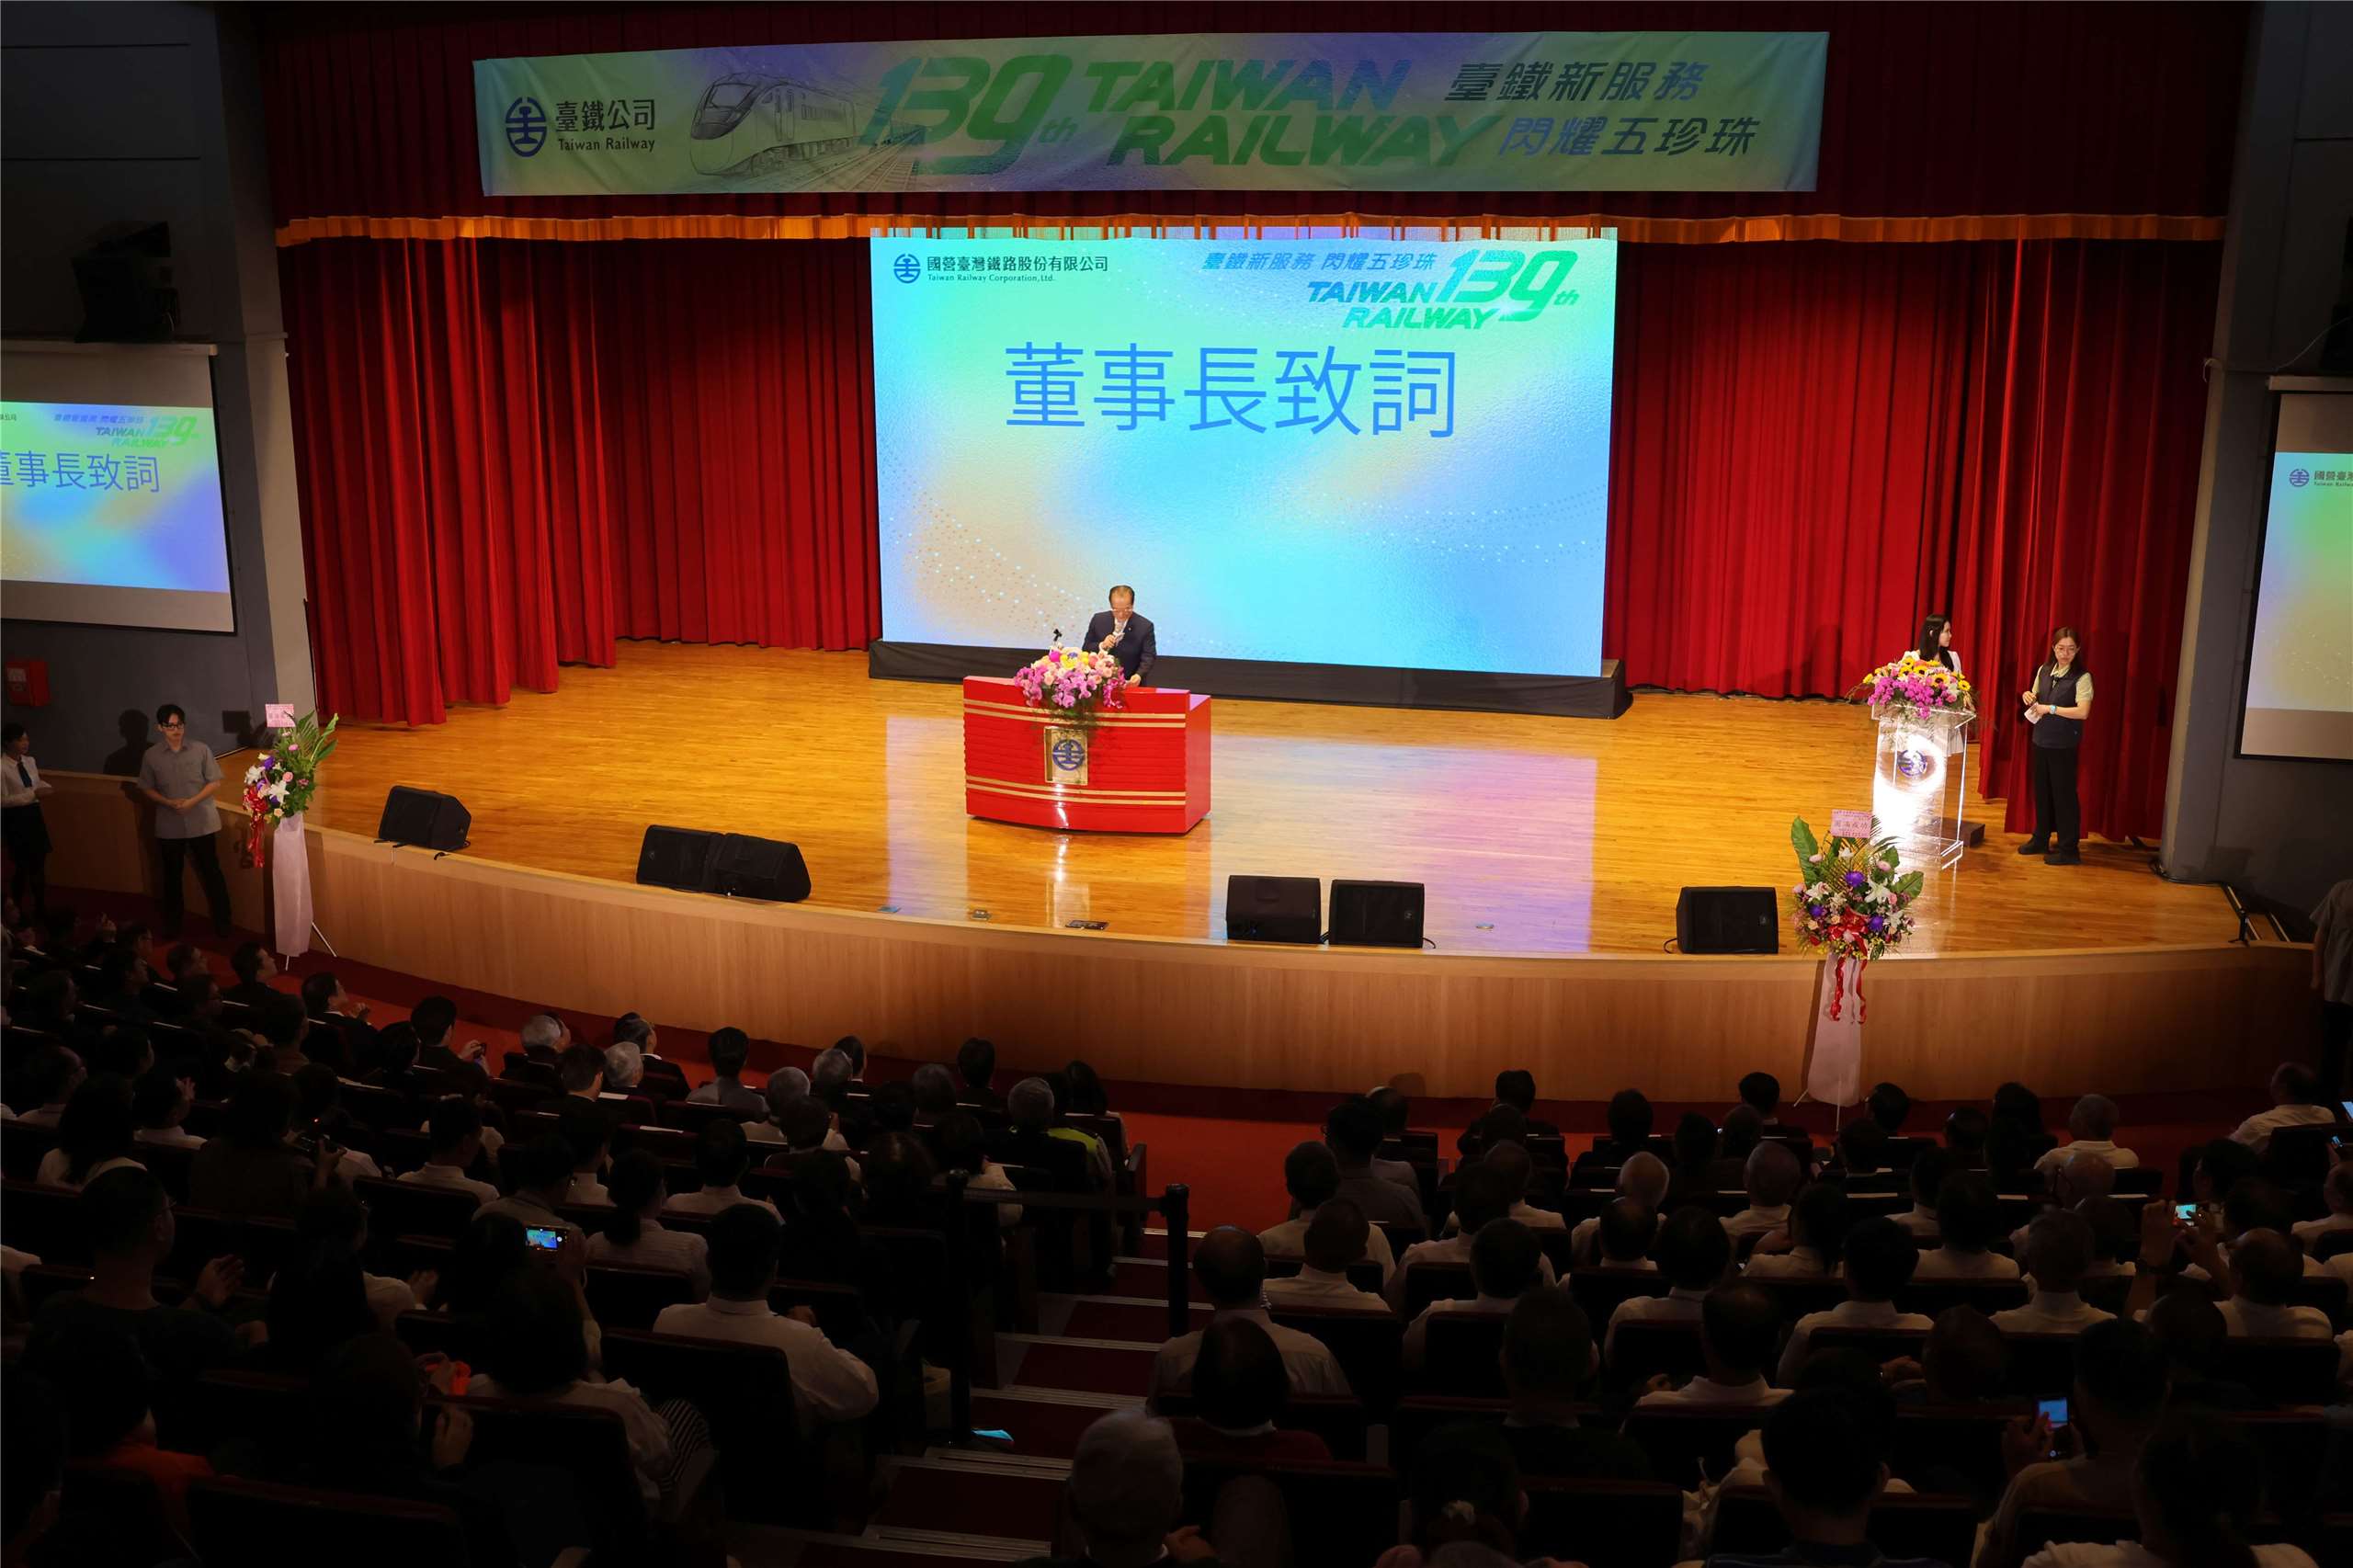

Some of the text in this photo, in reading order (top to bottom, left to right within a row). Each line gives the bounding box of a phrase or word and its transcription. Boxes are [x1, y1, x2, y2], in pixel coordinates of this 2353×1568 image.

[1085, 60, 1412, 112] TAIWAN
[1445, 62, 1710, 101] 臺鐵新服務
[556, 99, 655, 131] 臺鐵公司
[558, 136, 655, 153] Taiwan Railway
[1107, 114, 1505, 166] RAILWAY
[1499, 116, 1761, 156] 閃耀五珍珠
[926, 256, 1108, 272] 國營臺灣鐵路股份有限公司
[1202, 252, 1438, 270] 臺鐵新服務 閃耀五珍珠
[958, 274, 986, 283] Railway
[1308, 281, 1438, 303] TAIWAN
[1343, 307, 1500, 329] RAILWAY
[1006, 341, 1456, 438] 董事長致詞
[96, 426, 145, 437] TAIWAN
